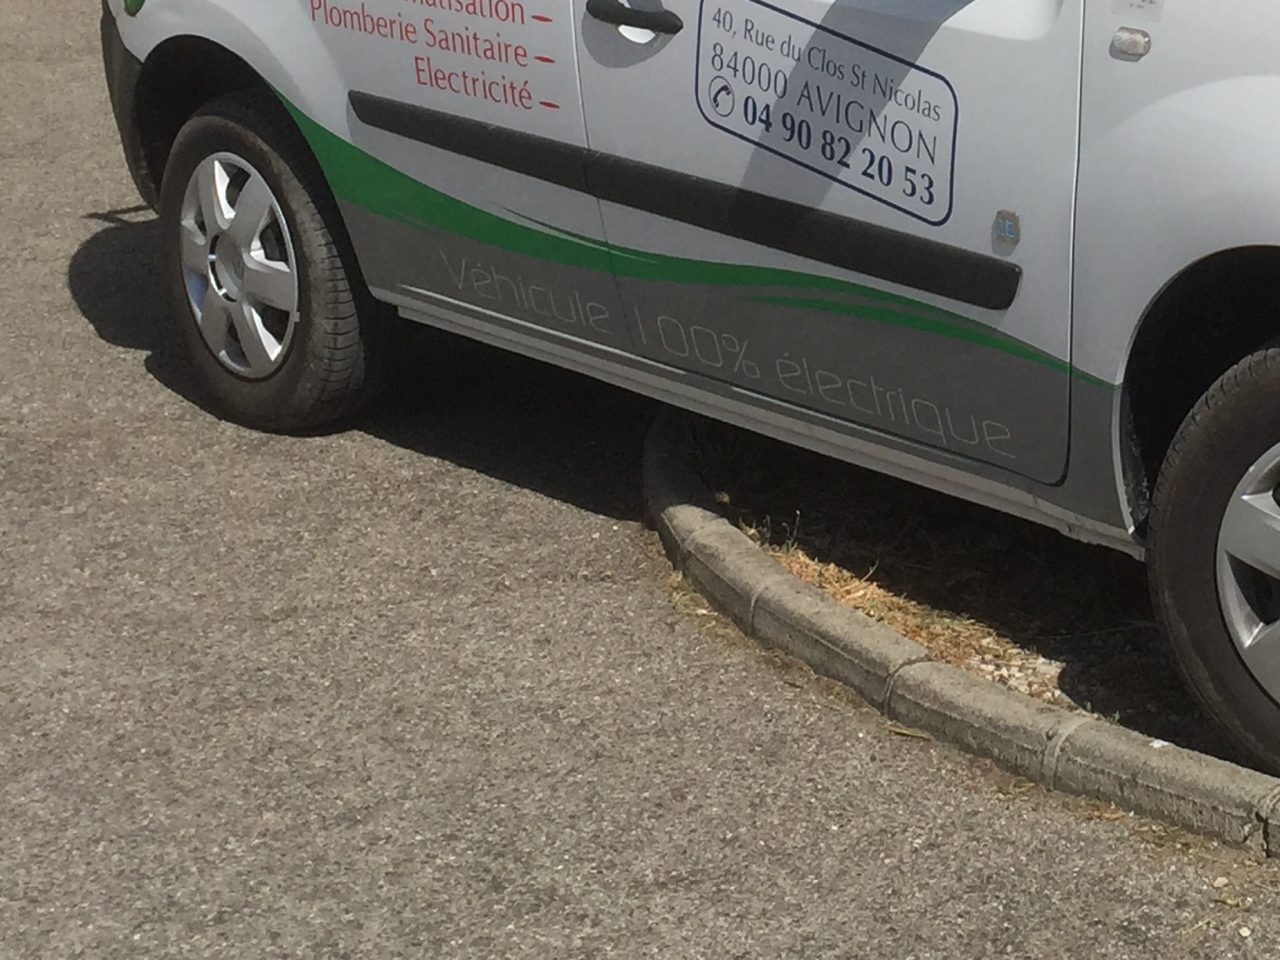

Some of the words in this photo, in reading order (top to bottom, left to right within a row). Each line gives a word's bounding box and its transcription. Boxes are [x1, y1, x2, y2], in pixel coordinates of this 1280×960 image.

[414, 56, 533, 111] Electricité
[424, 18, 529, 68] Sanitaire
[712, 7, 738, 39] 40,
[743, 18, 776, 51] Rue
[780, 34, 802, 62] du
[807, 45, 845, 81] Clos
[850, 63, 867, 91] St
[873, 73, 942, 123] Nicolas
[711, 42, 788, 100] 84000
[796, 81, 937, 166] AVIGNON
[743, 96, 773, 133] 04
[781, 112, 812, 151] 90
[820, 129, 851, 169] 82
[861, 147, 893, 187] 20
[902, 166, 935, 207] 53
[439, 249, 613, 335] Véhicule
[634, 306, 761, 379] 100%
[775, 352, 1017, 459] électrique
